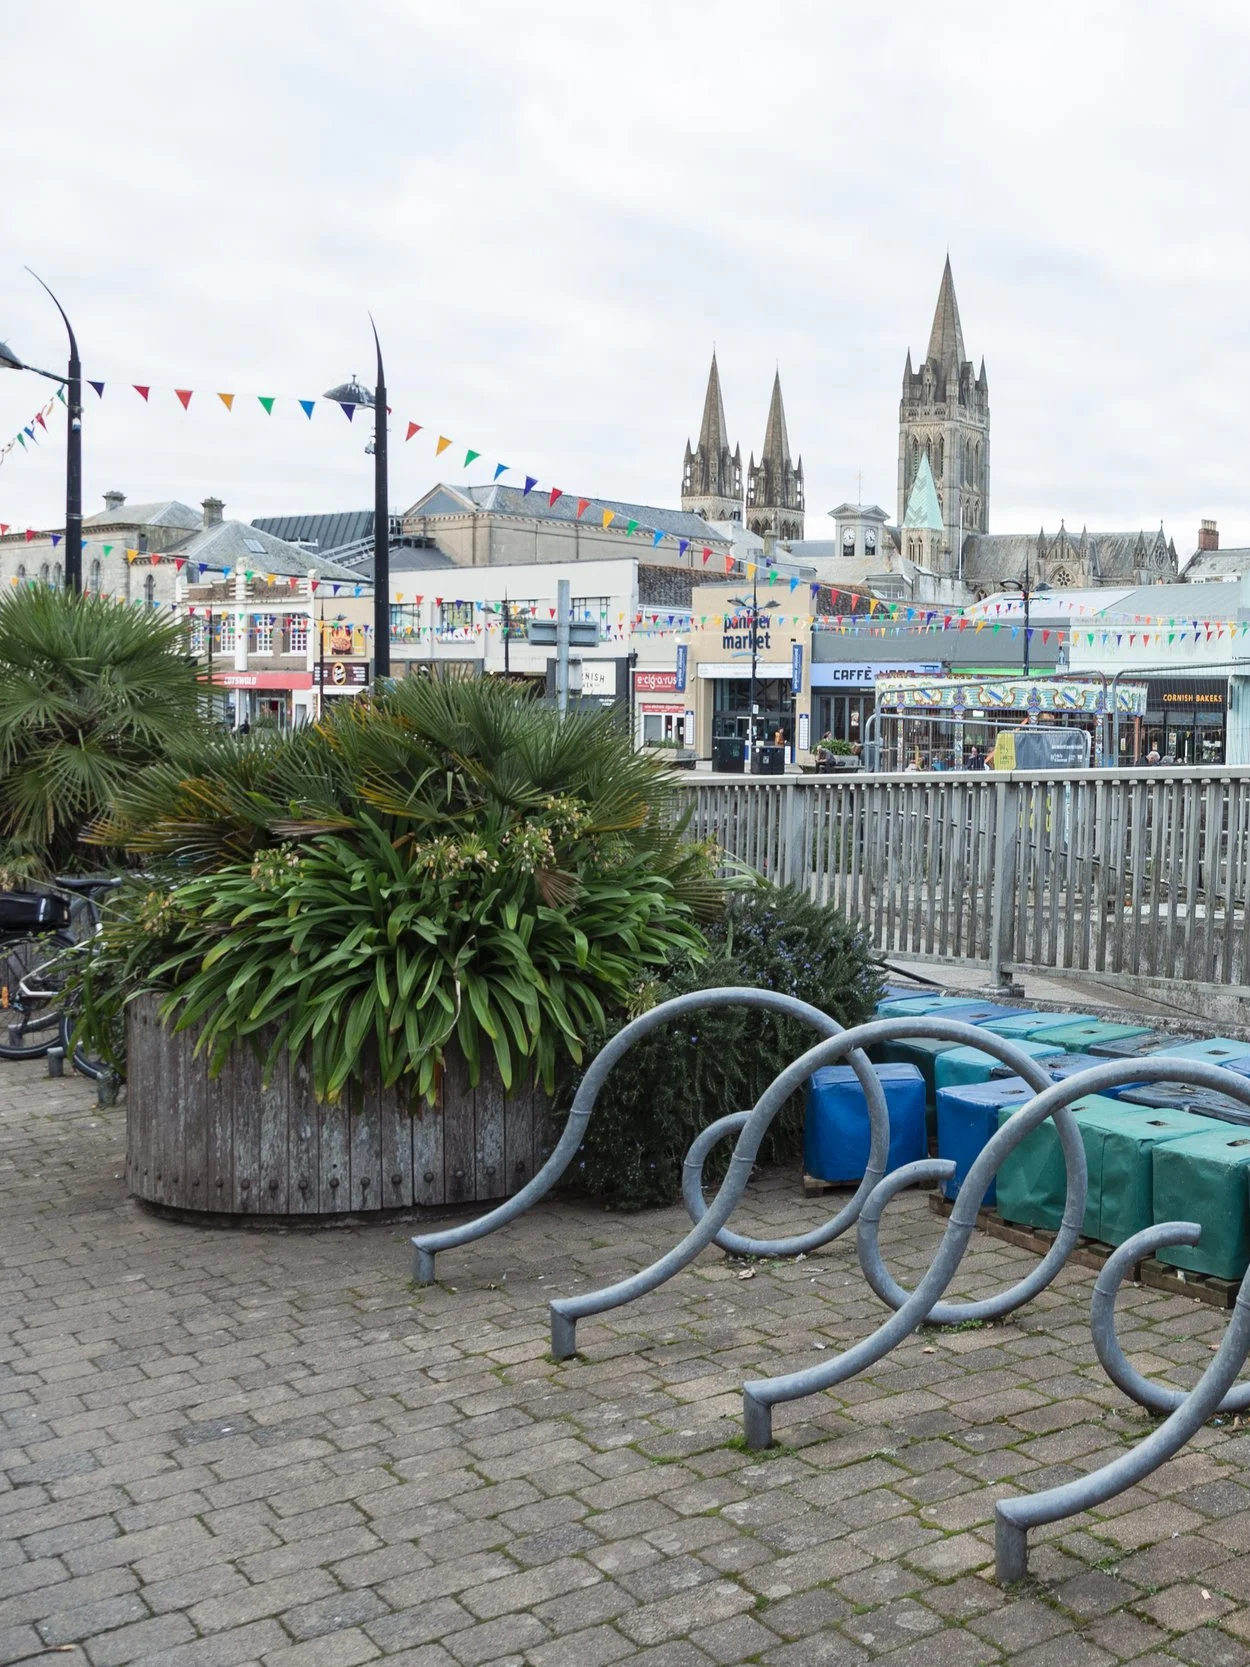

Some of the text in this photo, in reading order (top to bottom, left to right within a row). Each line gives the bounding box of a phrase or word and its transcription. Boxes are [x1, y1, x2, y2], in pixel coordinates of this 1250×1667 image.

[724, 613, 770, 633] paner
[581, 672, 605, 683] NISH
[1163, 694, 1222, 703] CORNISH BAKERS
